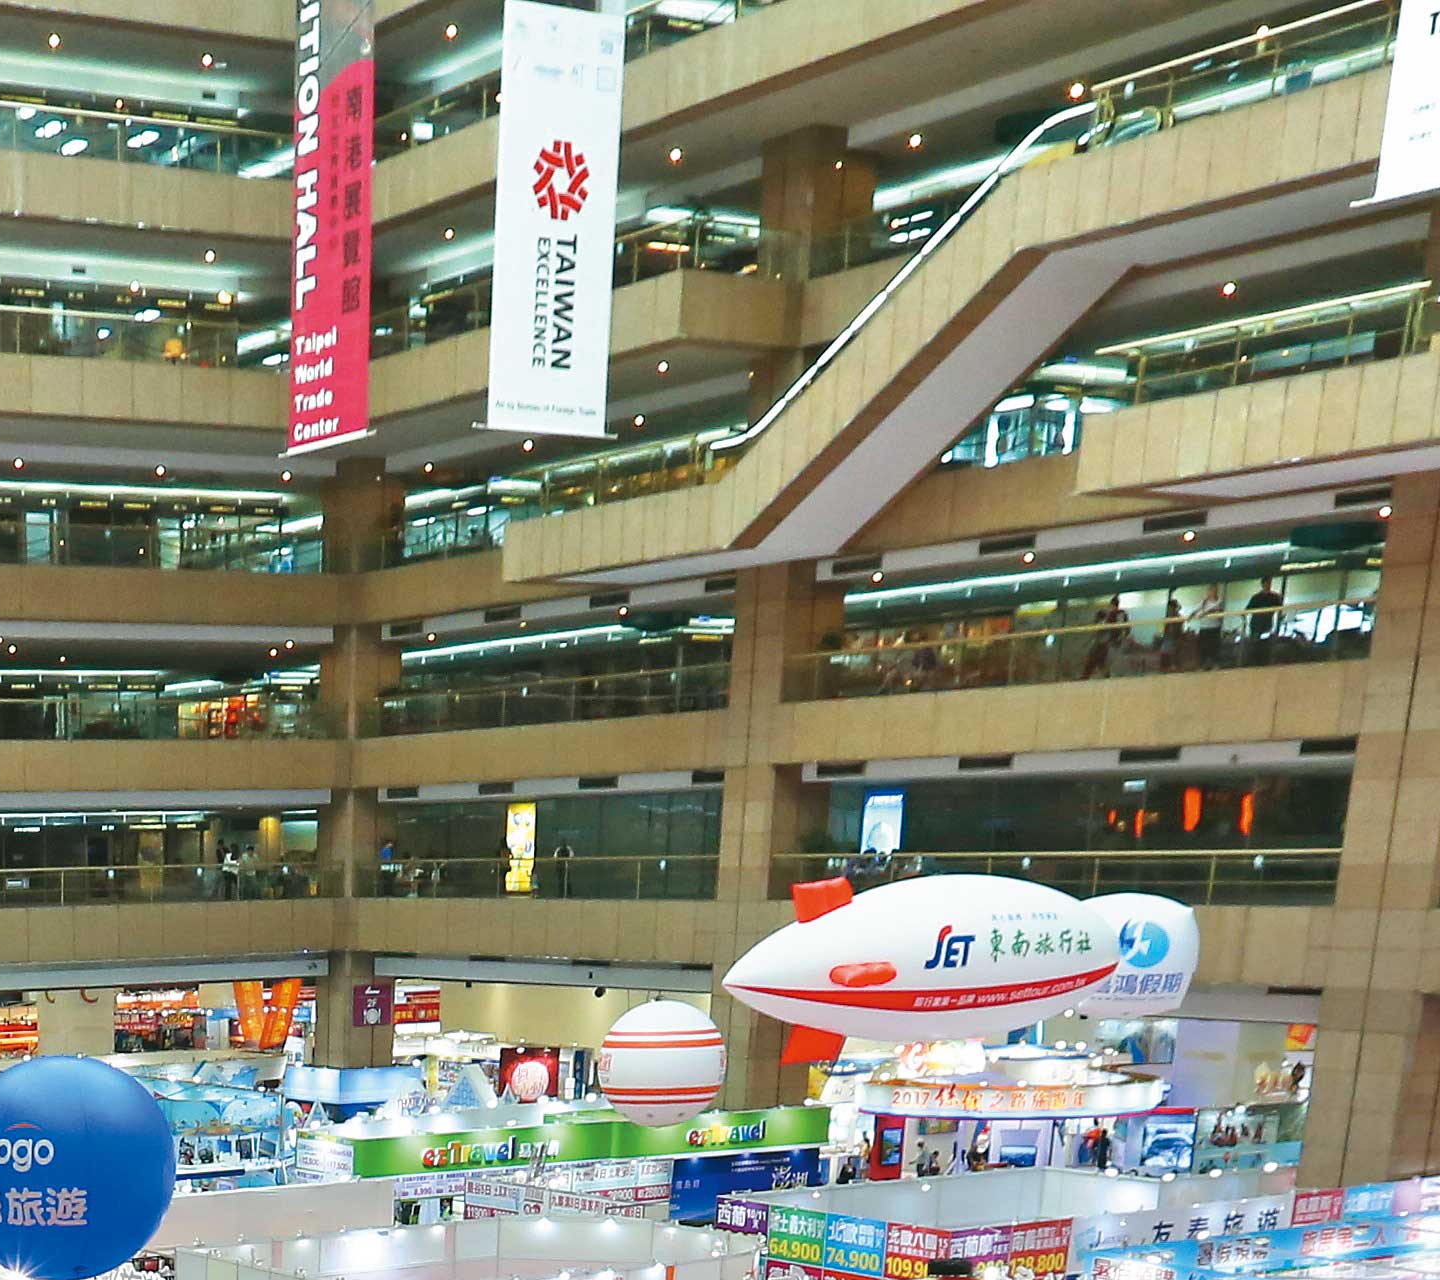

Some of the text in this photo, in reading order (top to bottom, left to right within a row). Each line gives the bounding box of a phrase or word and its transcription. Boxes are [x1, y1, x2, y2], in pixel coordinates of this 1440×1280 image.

[296, 0, 320, 311] ITION HALL
[531, 236, 551, 368] EXCELLENCE
[551, 233, 577, 371] TAIWAN
[295, 326, 338, 357] Taipei
[294, 357, 334, 386] World
[294, 387, 334, 414] Trade
[294, 415, 339, 443] Center
[988, 928, 1092, 961] 東南旅行社
[826, 1246, 880, 1271] 74,900
